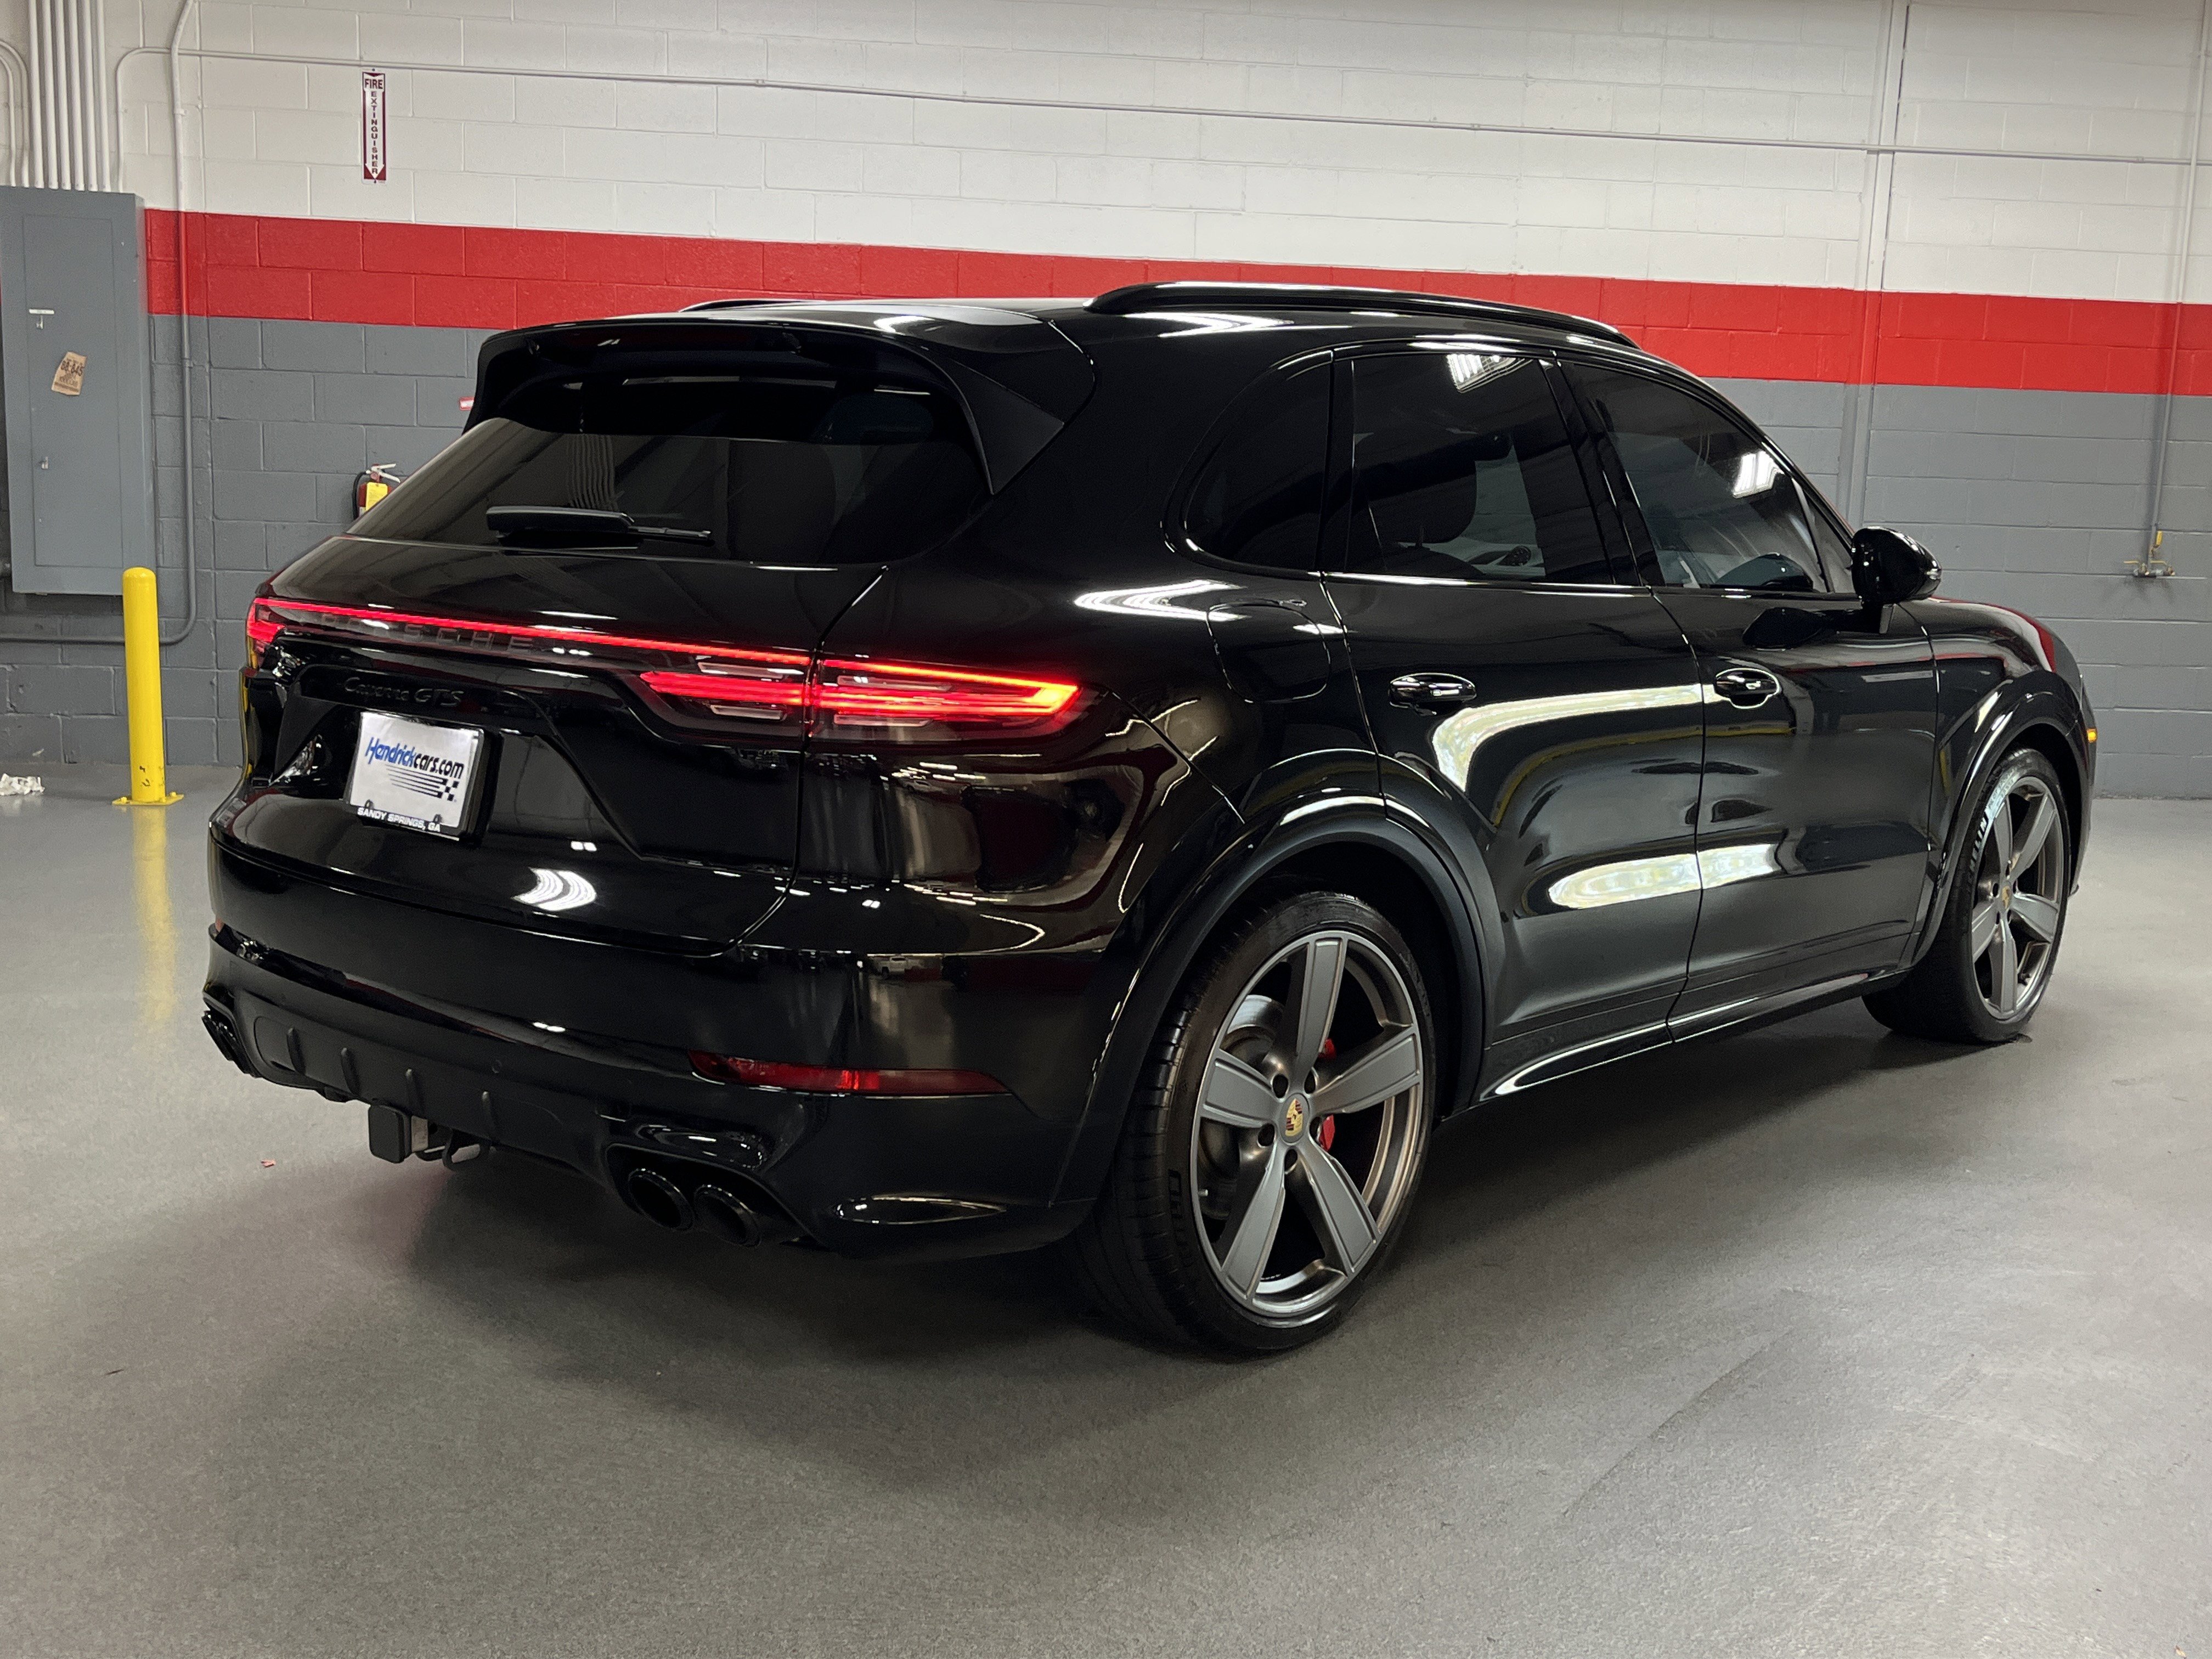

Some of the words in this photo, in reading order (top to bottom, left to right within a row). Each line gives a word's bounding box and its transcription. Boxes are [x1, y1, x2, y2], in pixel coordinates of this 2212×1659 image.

[365, 78, 383, 89] FIRE
[414, 688, 465, 707] GTS
[365, 736, 465, 779] Hendrickcars.com
[357, 806, 387, 821] SANDY
[387, 813, 426, 831] SPRINGS,
[428, 822, 441, 832] GA
